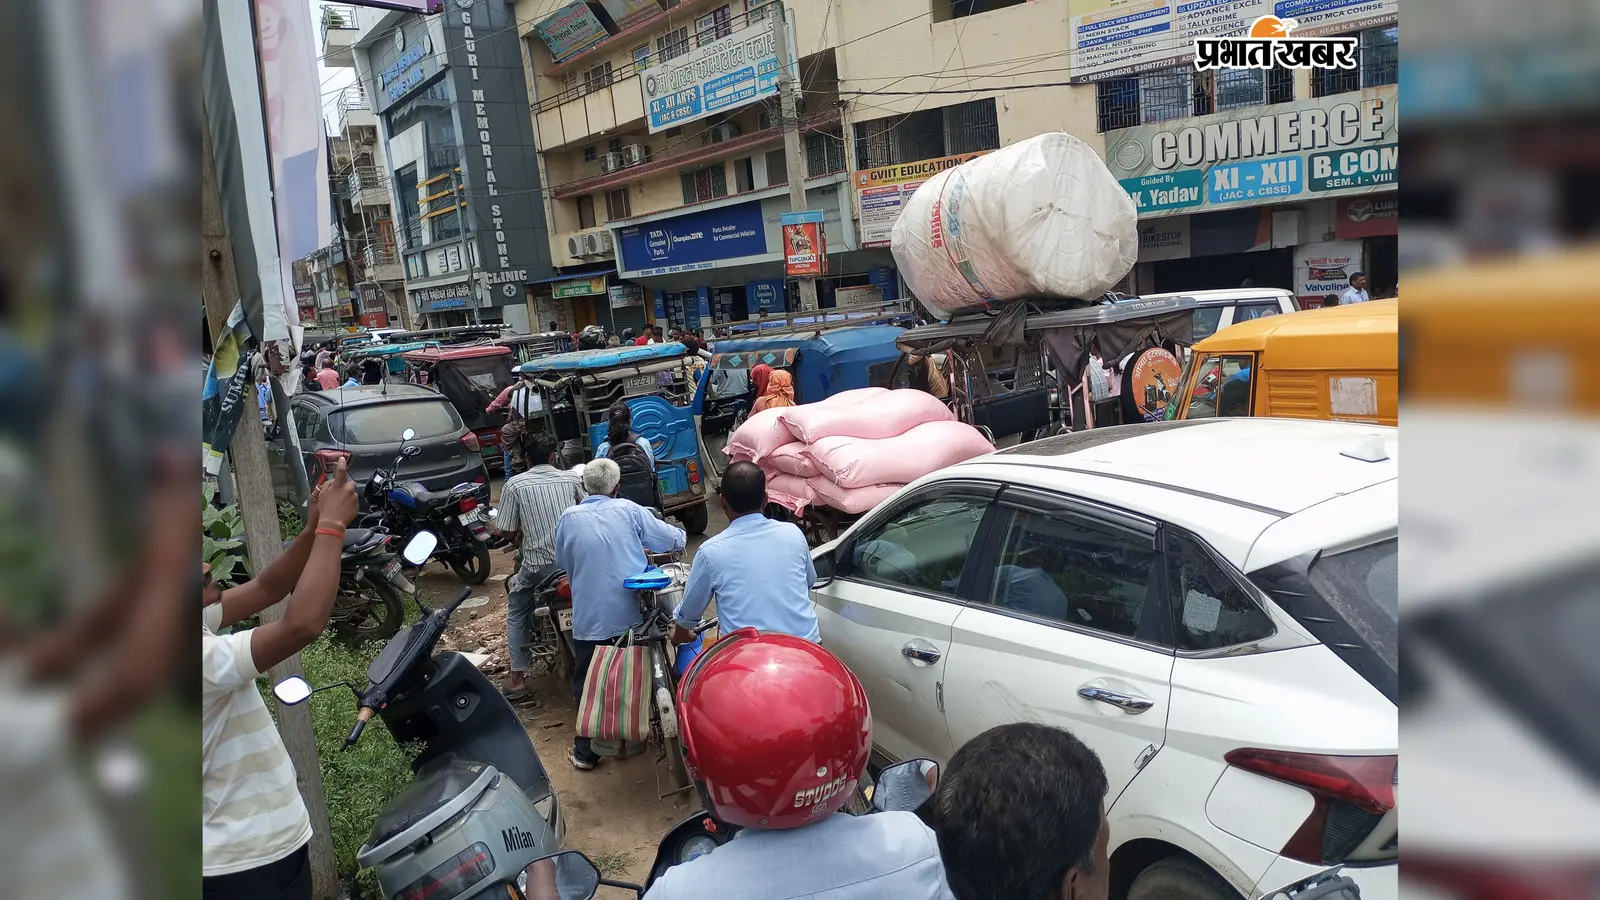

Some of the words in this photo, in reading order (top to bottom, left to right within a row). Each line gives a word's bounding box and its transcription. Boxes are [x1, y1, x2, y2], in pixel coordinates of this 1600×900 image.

[1098, 20, 1115, 28] STACK
[1128, 8, 1169, 22] DEVELOPMENT
[1187, 4, 1230, 20] ADVANCE
[1188, 18, 1210, 29] TALLY
[1212, 13, 1237, 23] PRIME
[1303, 14, 1323, 24] AND
[1325, 10, 1345, 20] MCA
[1346, 3, 1383, 14] COURSE
[1108, 24, 1130, 33] STACK
[1138, 27, 1153, 35] PHP
[1187, 29, 1208, 38] DATA
[1211, 20, 1245, 32] SCIENCE
[1320, 26, 1340, 35] NEAR
[1359, 14, 1398, 27] WOMEN'S
[1086, 51, 1119, 61] MACHINE
[1121, 42, 1157, 54] LEARNING
[652, 100, 661, 114] XI
[665, 96, 675, 110] XII
[676, 88, 696, 104] ARTS
[462, 12, 478, 80] GAURI
[472, 90, 498, 196] MEMORIAL
[492, 204, 510, 268] STONE
[1152, 99, 1384, 170] COMMERCE
[870, 167, 898, 180] GVIIT
[900, 158, 962, 178] EDUCATION
[1214, 167, 1239, 191] XI
[1261, 160, 1296, 185] XII
[1141, 175, 1164, 186] Guided
[1165, 175, 1174, 184] By
[1326, 178, 1354, 188] SEM.
[1372, 173, 1392, 182] VIII
[1149, 186, 1198, 206] Yadav
[1220, 190, 1243, 201] (JAC
[1258, 184, 1291, 195] CBSE)
[650, 230, 663, 239] TATA
[719, 232, 740, 241] Commercial
[650, 240, 667, 248] Genuine
[485, 270, 528, 285] CLINIC
[1305, 283, 1349, 292] Valvoline
[794, 773, 847, 807] STUDDS
[502, 826, 535, 852] Milan
